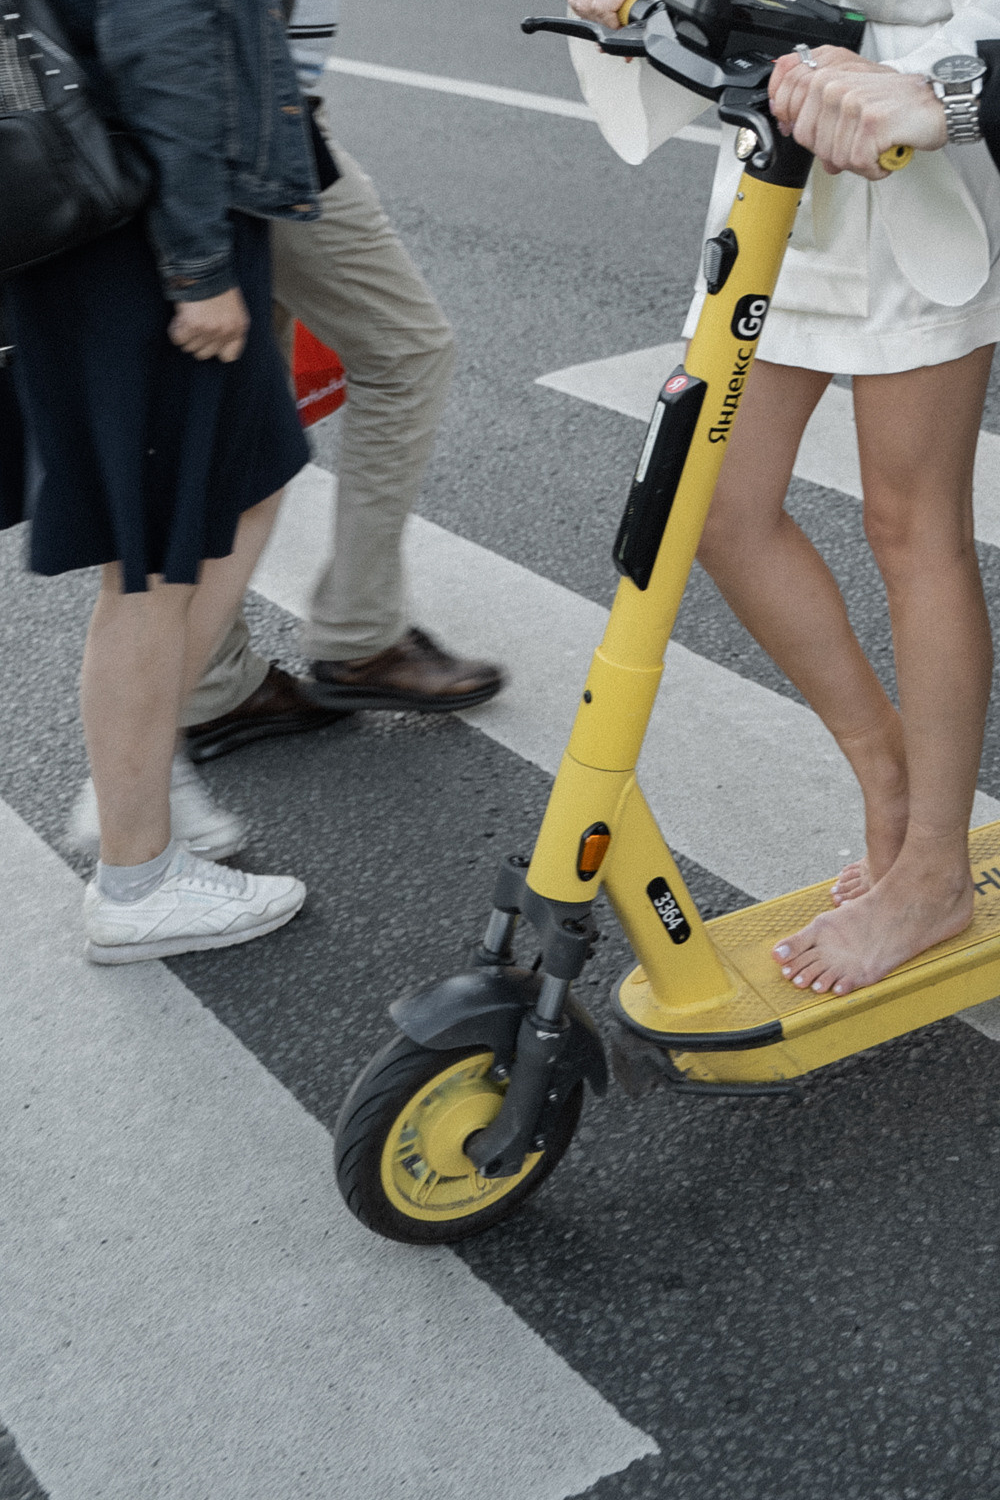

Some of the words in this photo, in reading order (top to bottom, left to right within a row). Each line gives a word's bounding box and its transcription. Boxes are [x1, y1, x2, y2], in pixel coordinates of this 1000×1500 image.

[669, 378, 687, 391] Я
[708, 347, 753, 443] Яндекс
[737, 299, 767, 337] Go
[653, 891, 685, 931] 3364
